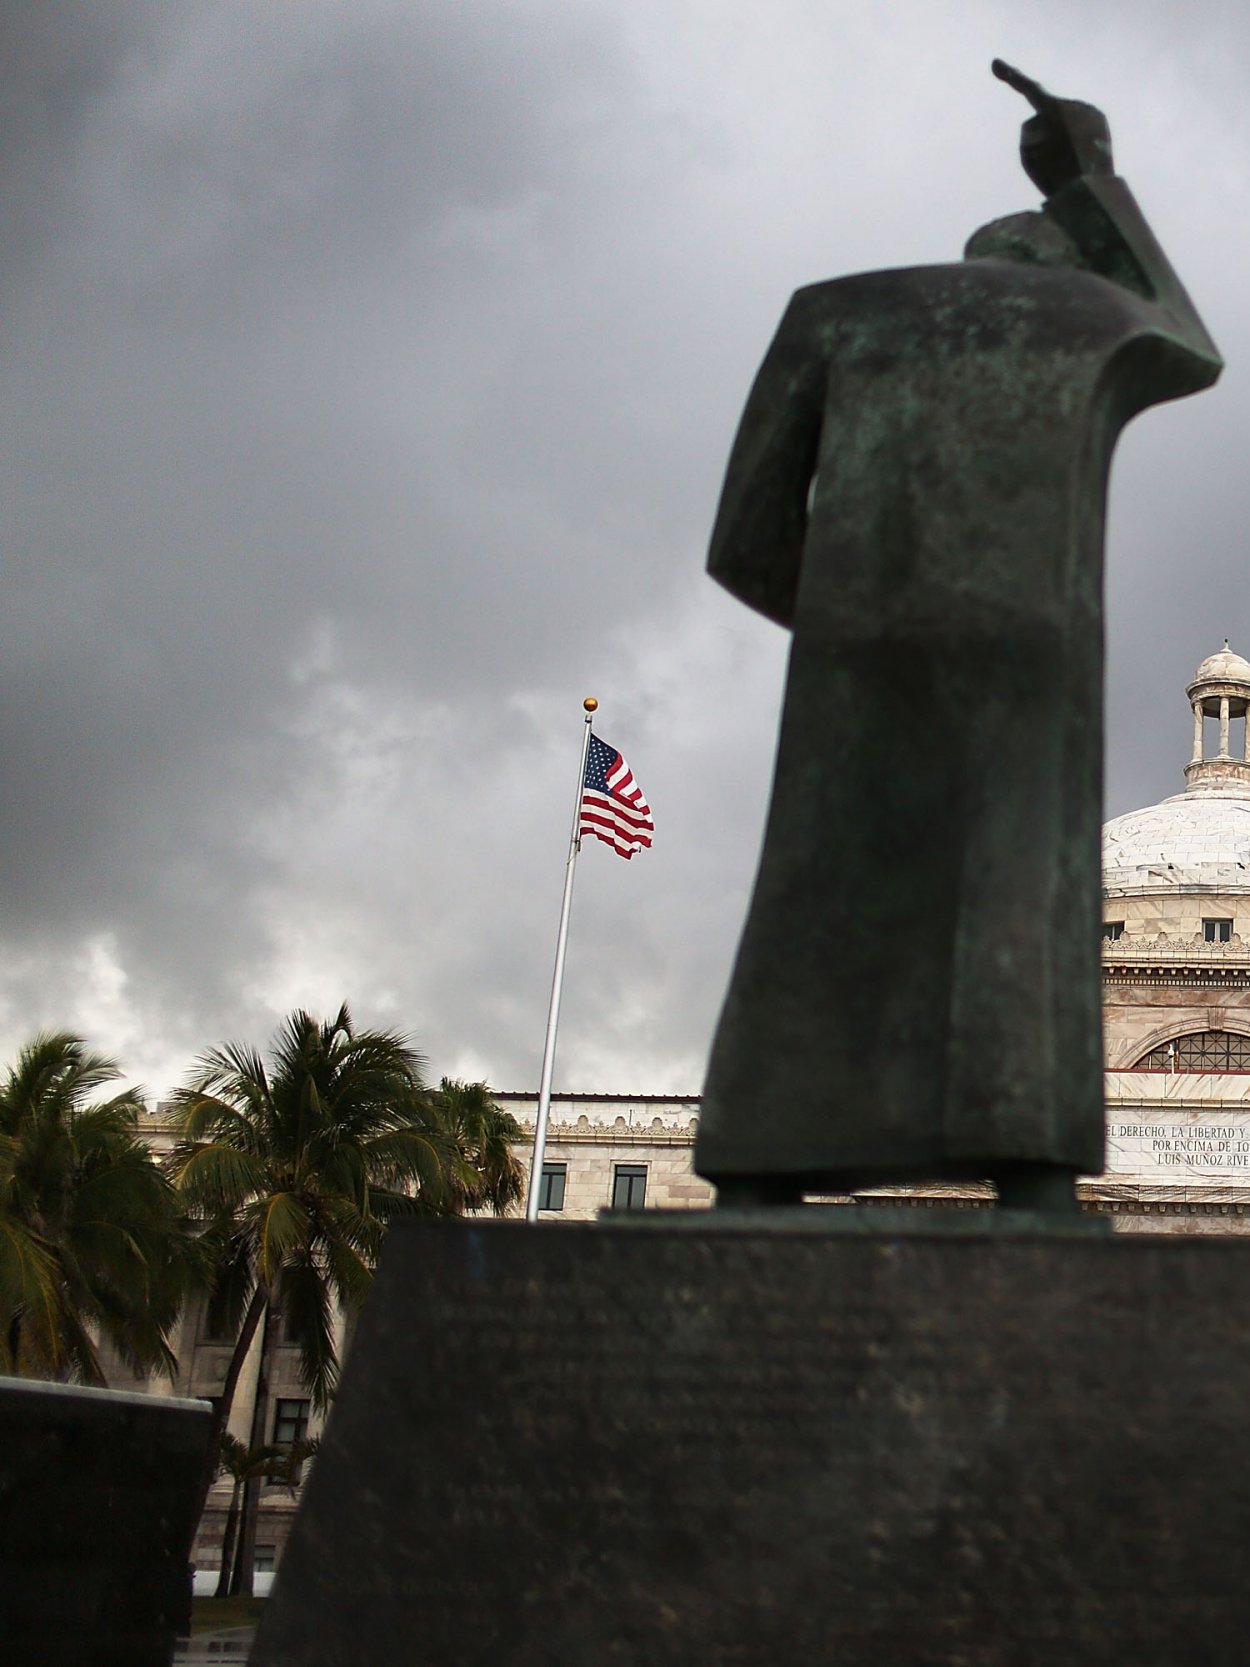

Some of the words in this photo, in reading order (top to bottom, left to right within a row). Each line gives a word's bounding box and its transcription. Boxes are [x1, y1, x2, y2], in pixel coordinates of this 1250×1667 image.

[1172, 1127, 1184, 1138] LA
[1188, 1128, 1235, 1138] LIBERTAD
[1239, 1128, 1246, 1138] Y
[1152, 1140, 1170, 1151] POR
[1174, 1140, 1212, 1152] ENCIMA
[1218, 1142, 1231, 1152] DE
[1158, 1154, 1181, 1164] LUIS
[1186, 1153, 1223, 1166] MUÑOZ
